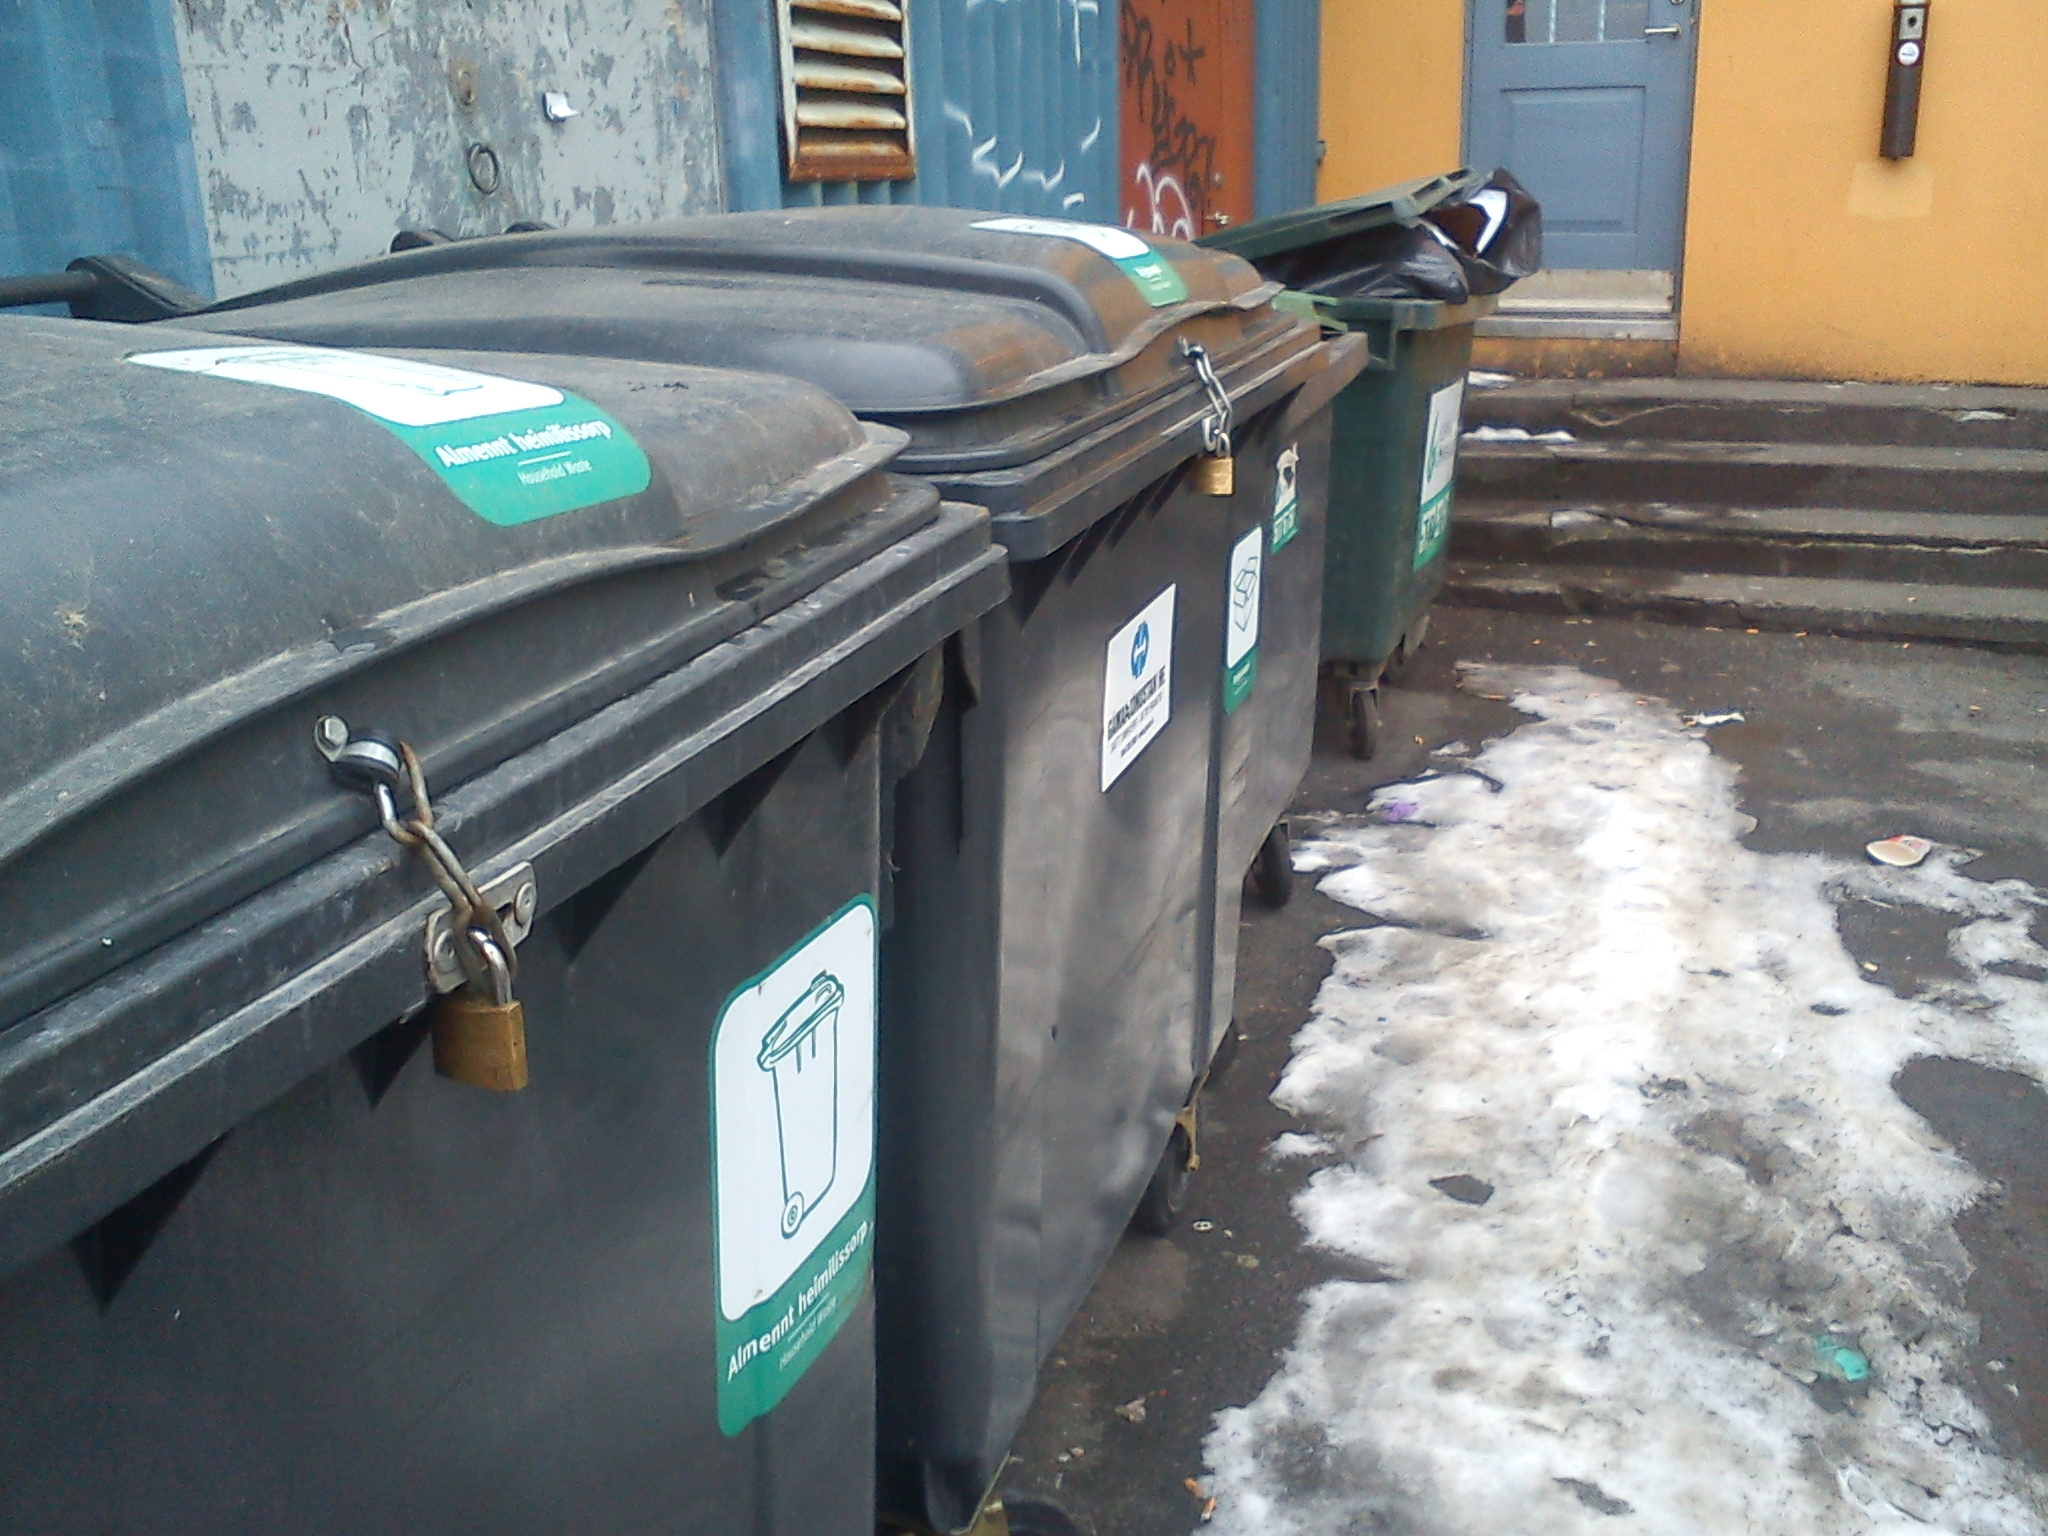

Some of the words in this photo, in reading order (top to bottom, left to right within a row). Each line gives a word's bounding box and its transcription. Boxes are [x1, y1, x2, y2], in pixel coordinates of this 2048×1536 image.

[435, 436, 518, 467] Almennt
[727, 1304, 795, 1383] Almennt
[798, 1221, 868, 1316] heimilissorp
